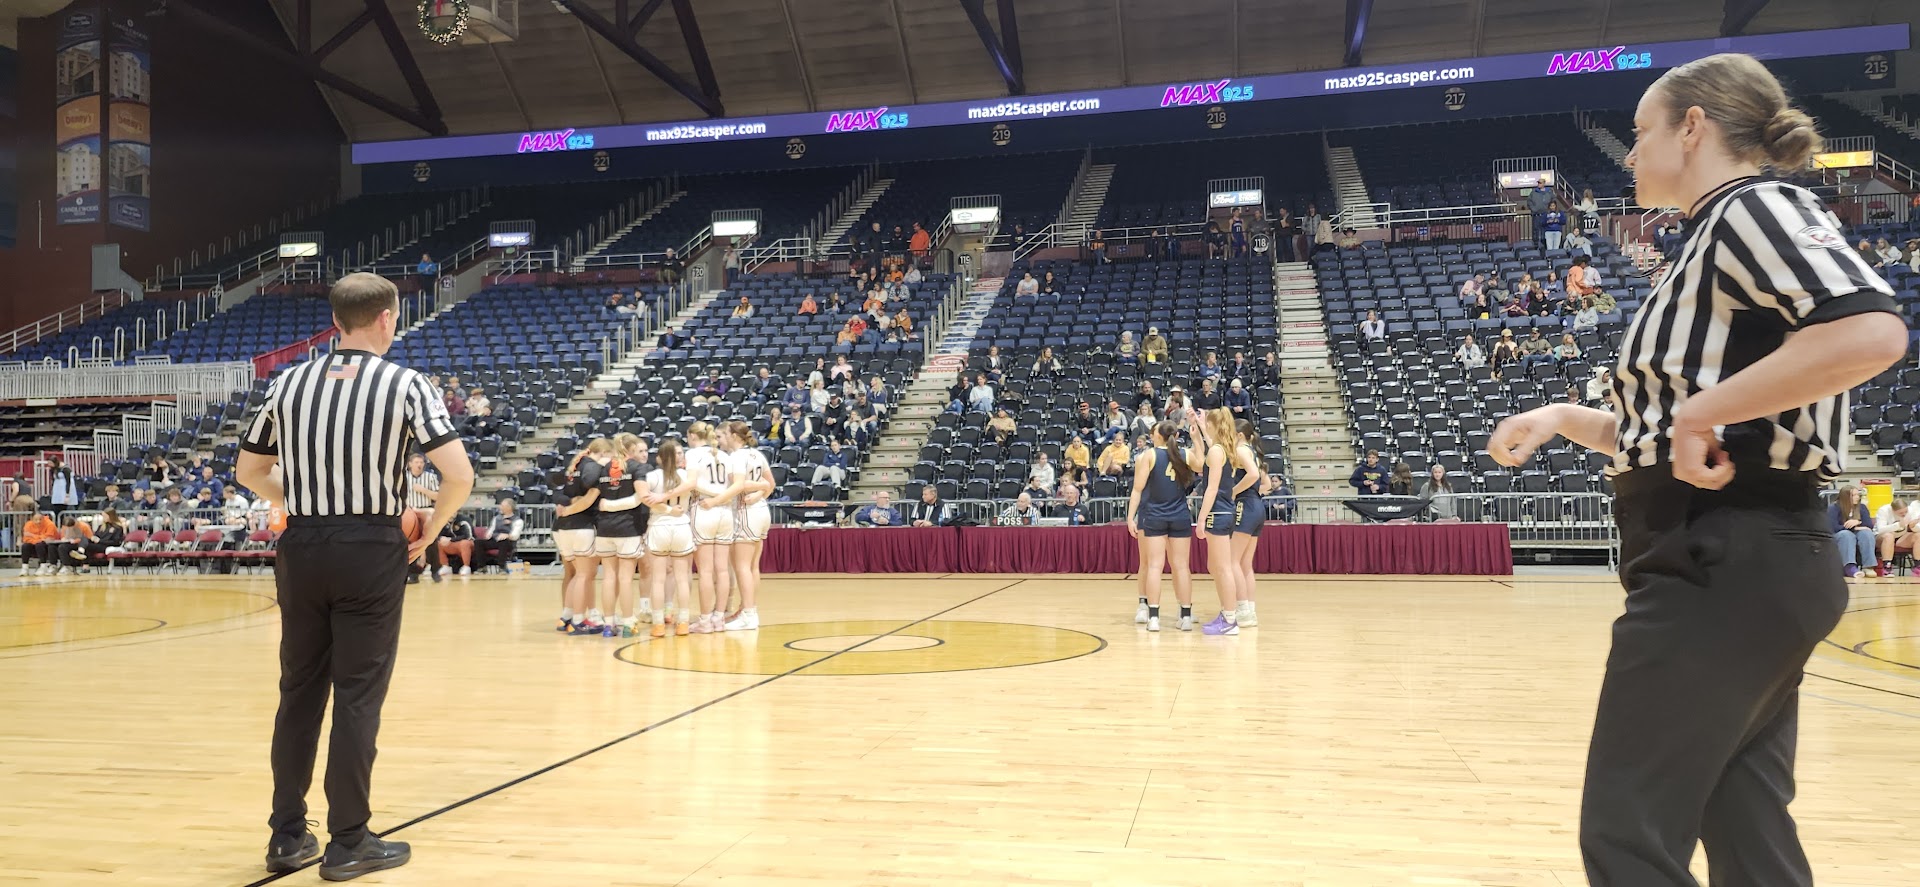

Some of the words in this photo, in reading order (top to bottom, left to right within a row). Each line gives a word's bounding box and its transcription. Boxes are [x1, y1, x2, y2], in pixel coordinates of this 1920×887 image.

[1546, 45, 1626, 75] MAX
[1617, 52, 1652, 70] 92.5
[1864, 61, 1888, 74] 215
[1324, 66, 1475, 90] max925casper.com
[1160, 79, 1231, 107] MAX
[1222, 85, 1254, 102] 92.5
[1445, 93, 1466, 105] 217
[968, 98, 1100, 119] max925casper.com
[825, 106, 889, 133] MAX
[1207, 112, 1227, 124] 218
[646, 122, 767, 141] max925casper.com
[992, 129, 1011, 141] 219
[517, 128, 575, 153] MAX
[785, 143, 806, 155] 220
[593, 157, 610, 167] 221
[413, 167, 431, 177] 222
[1584, 219, 1596, 229] 117
[1254, 238, 1267, 248] 118
[706, 462, 726, 485] 10
[748, 466, 762, 483] 12
